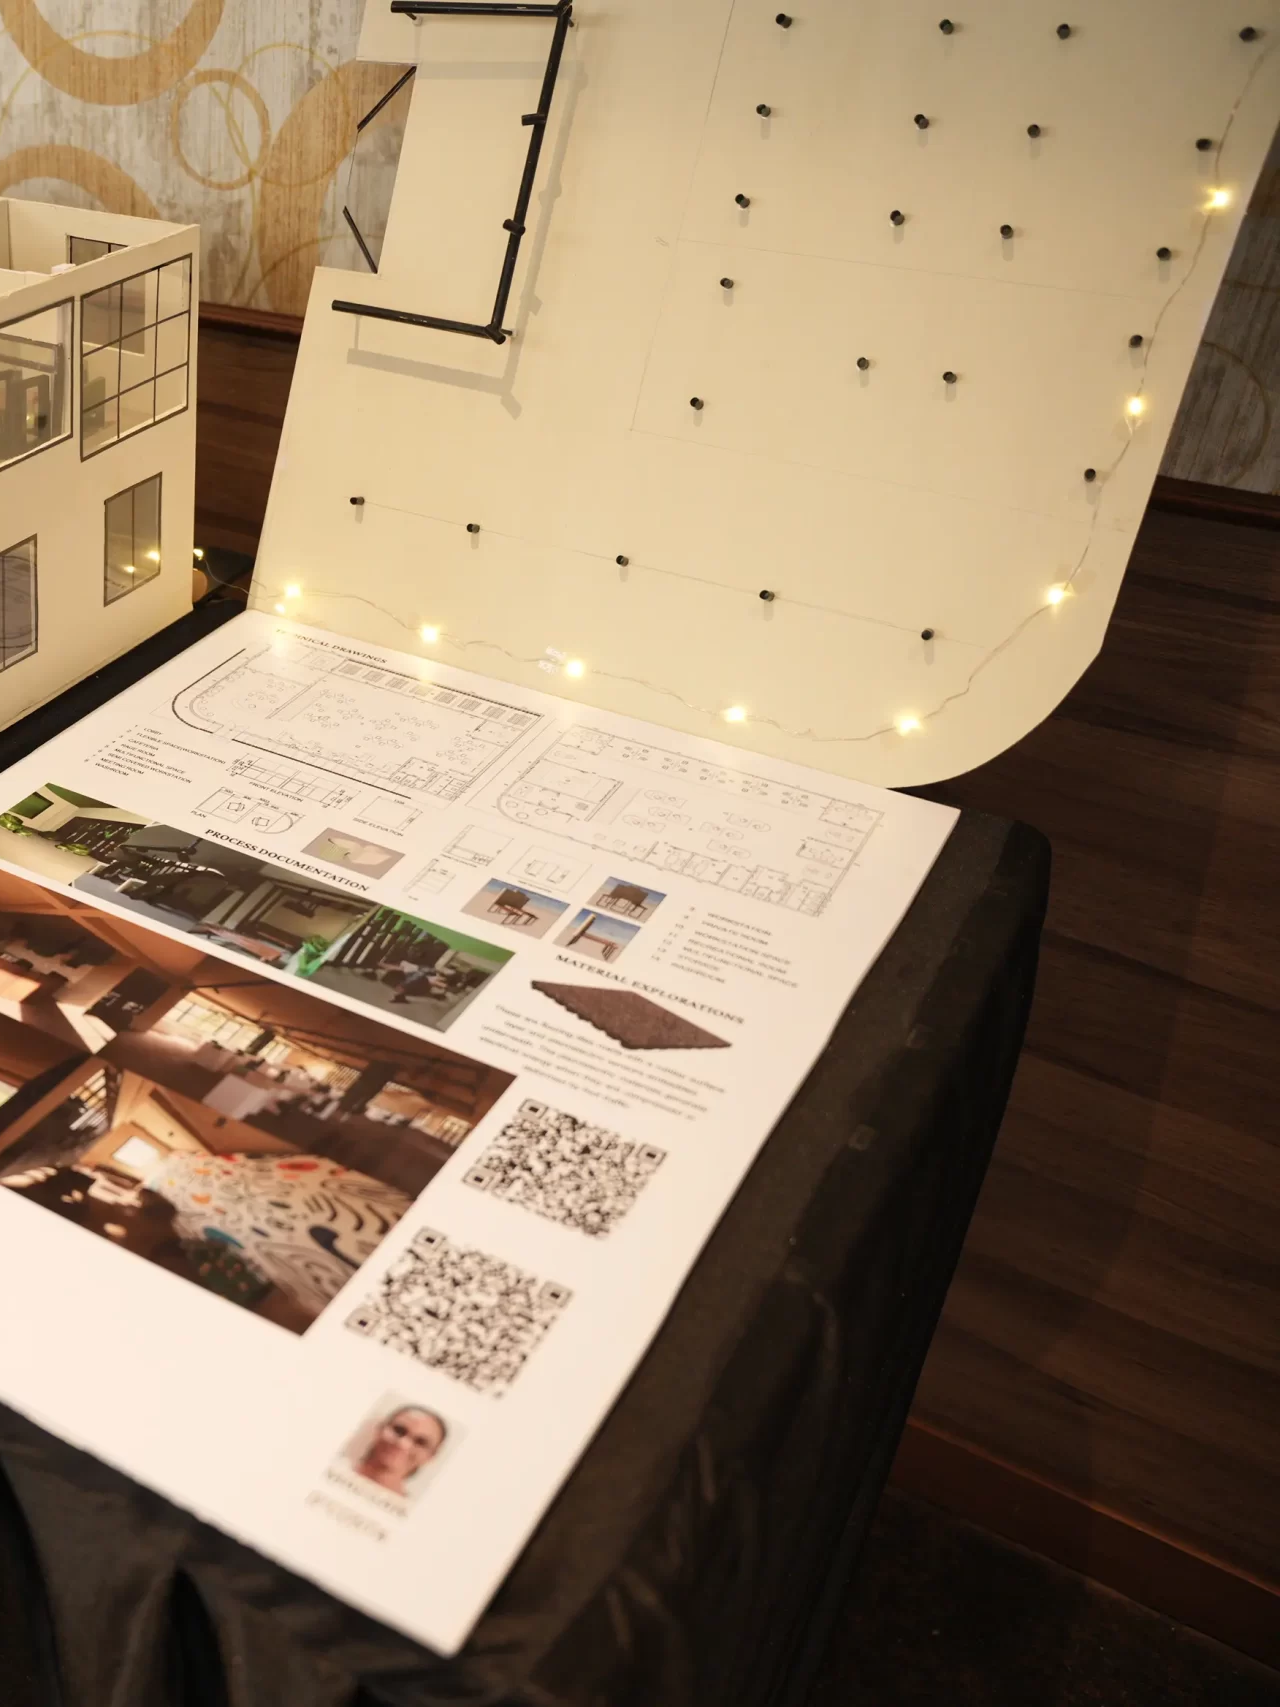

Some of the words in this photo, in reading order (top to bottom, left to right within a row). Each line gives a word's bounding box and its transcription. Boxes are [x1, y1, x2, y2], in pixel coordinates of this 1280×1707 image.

[332, 645, 387, 664] DRAWINGS
[128, 738, 159, 751] CAFETERIA
[248, 781, 270, 791] FRONT
[270, 788, 304, 802] ELEVATION
[190, 810, 208, 819] PLAN
[369, 822, 404, 837] ELEVATION
[205, 828, 259, 852] PROCESS
[258, 848, 370, 892] DOCUMENTATION
[555, 954, 628, 984] MATERIAL
[631, 979, 745, 1025] EXPLORATIONS
